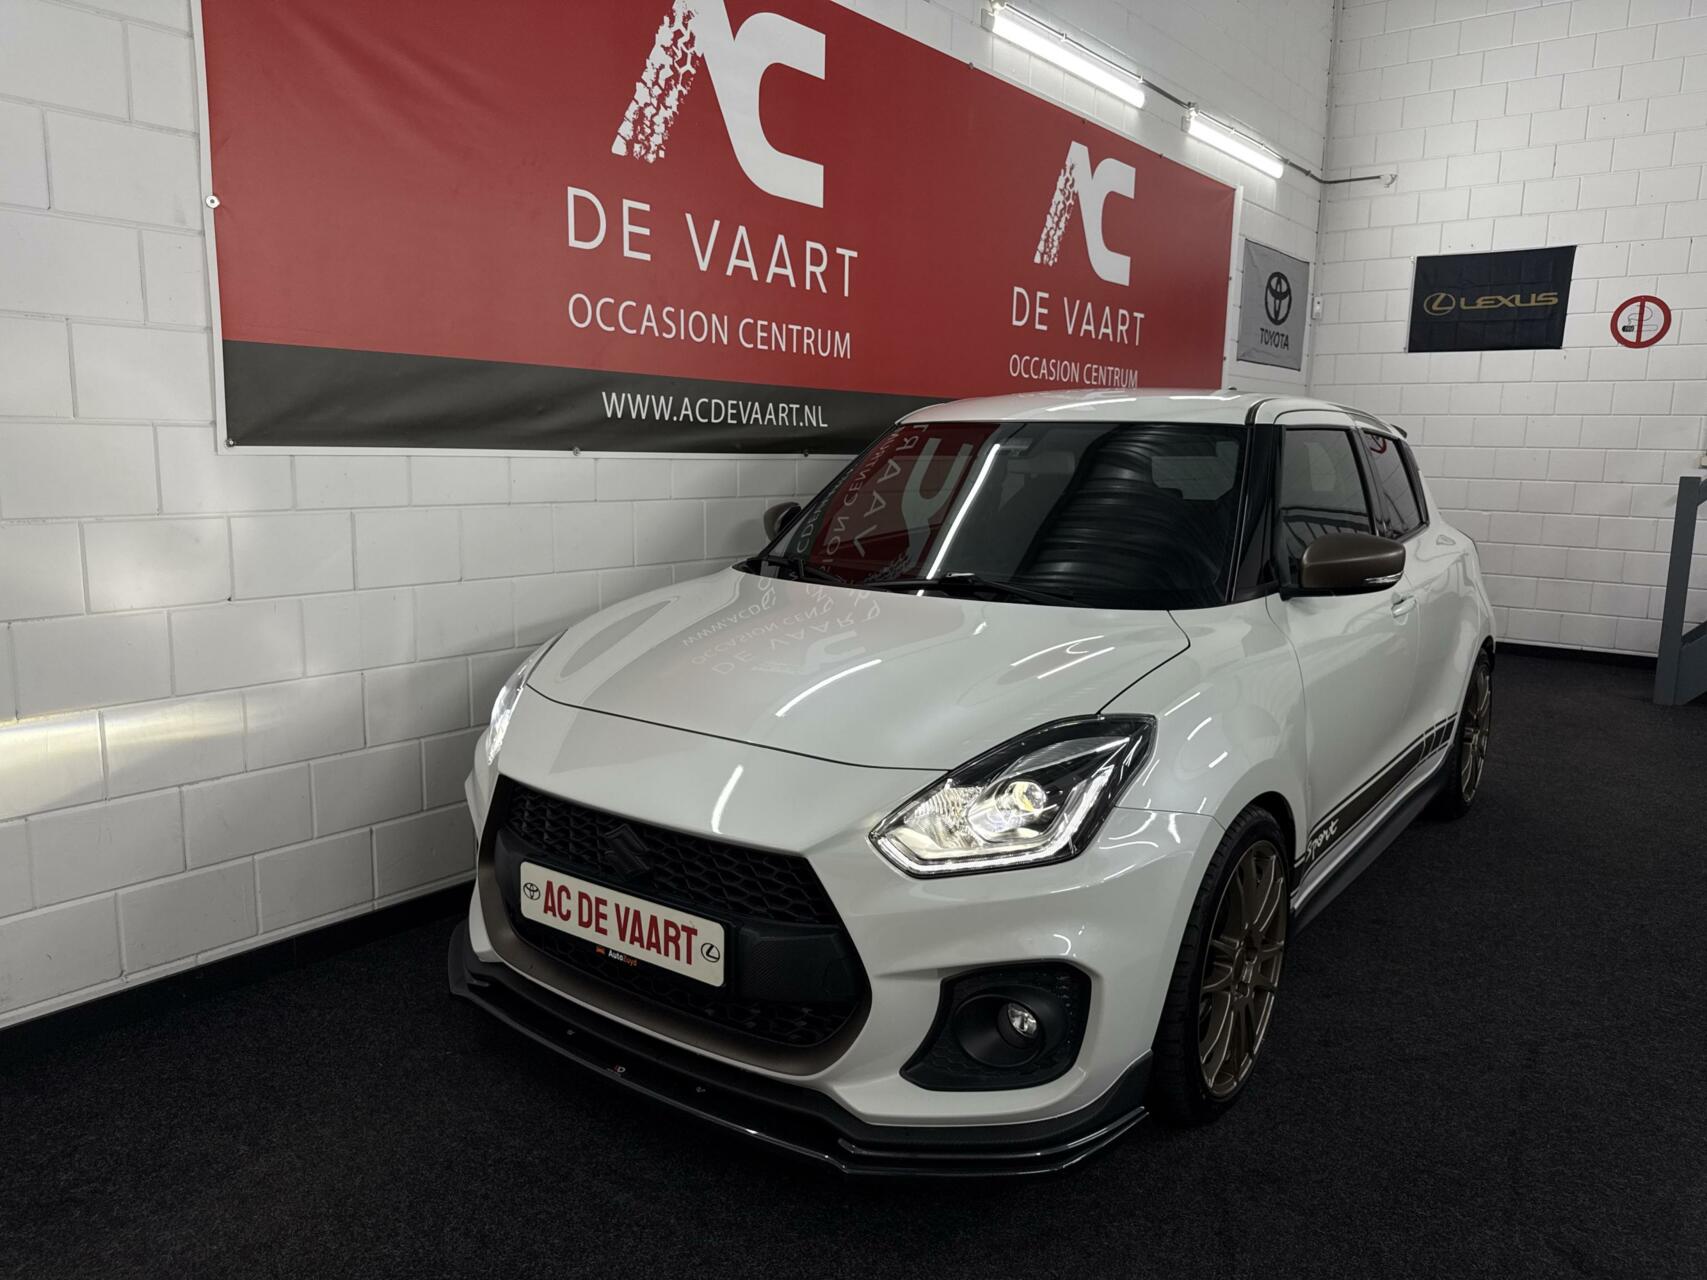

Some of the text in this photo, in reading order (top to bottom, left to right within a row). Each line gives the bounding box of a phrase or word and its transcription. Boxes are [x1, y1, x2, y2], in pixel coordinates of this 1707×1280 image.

[567, 186, 858, 297] DE VAART
[1012, 286, 1145, 346] DE VAART
[1459, 291, 1558, 310] LEXUS
[568, 293, 851, 360] OCCASION CENTRUM
[1259, 327, 1290, 351] TOYOTA
[1009, 354, 1138, 388] OCCASION CENTRUM
[602, 391, 828, 428] WWW.ACDEVAART.NL
[1305, 818, 1339, 862] Sport
[543, 879, 698, 965] AC DE VAART
